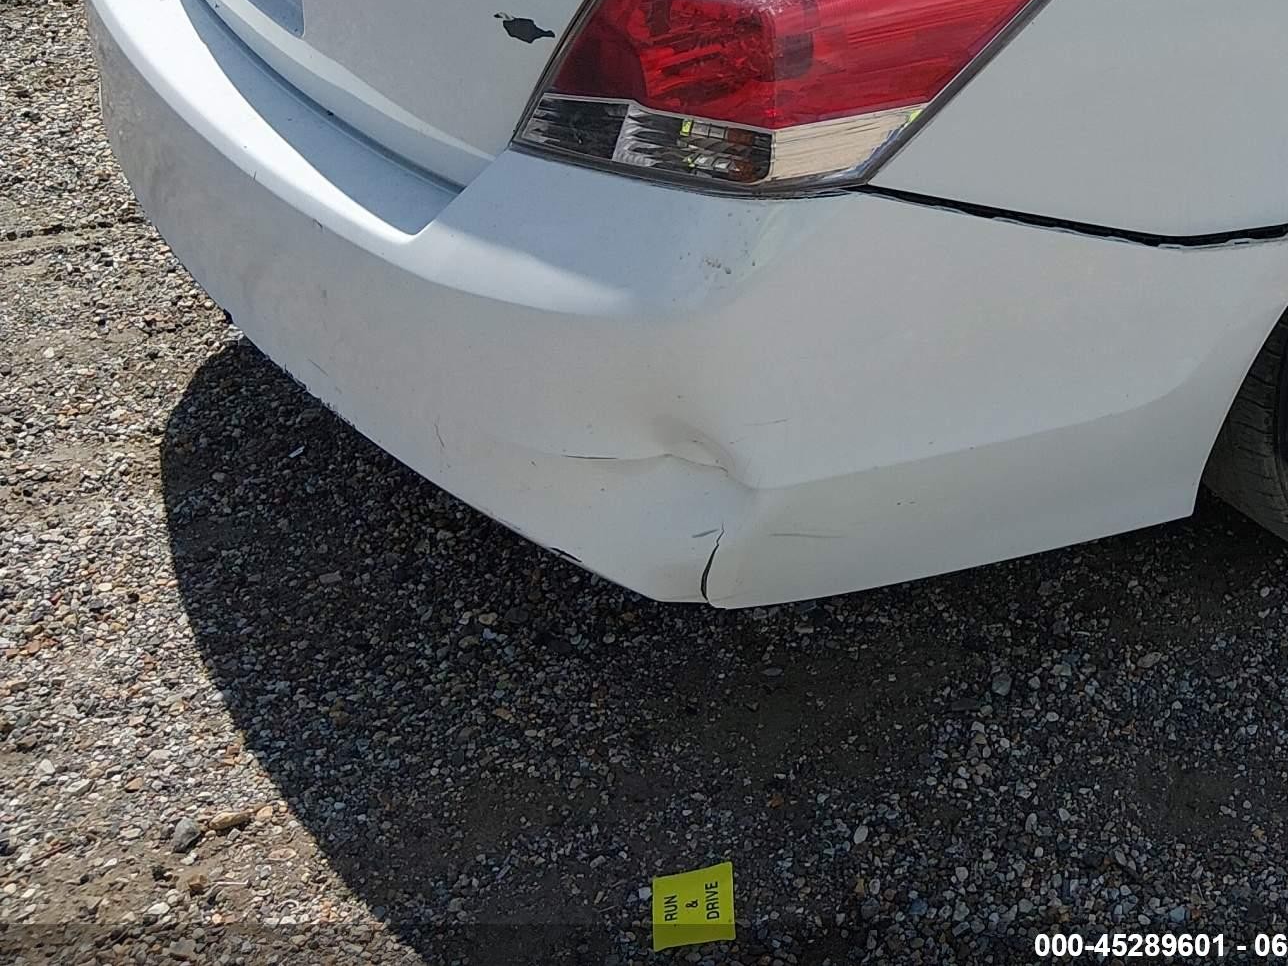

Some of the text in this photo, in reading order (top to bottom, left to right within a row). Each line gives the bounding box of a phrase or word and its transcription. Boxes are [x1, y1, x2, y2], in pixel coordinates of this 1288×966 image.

[664, 895, 678, 922] RUN
[685, 899, 698, 909] &
[705, 881, 720, 920] DRIVE
